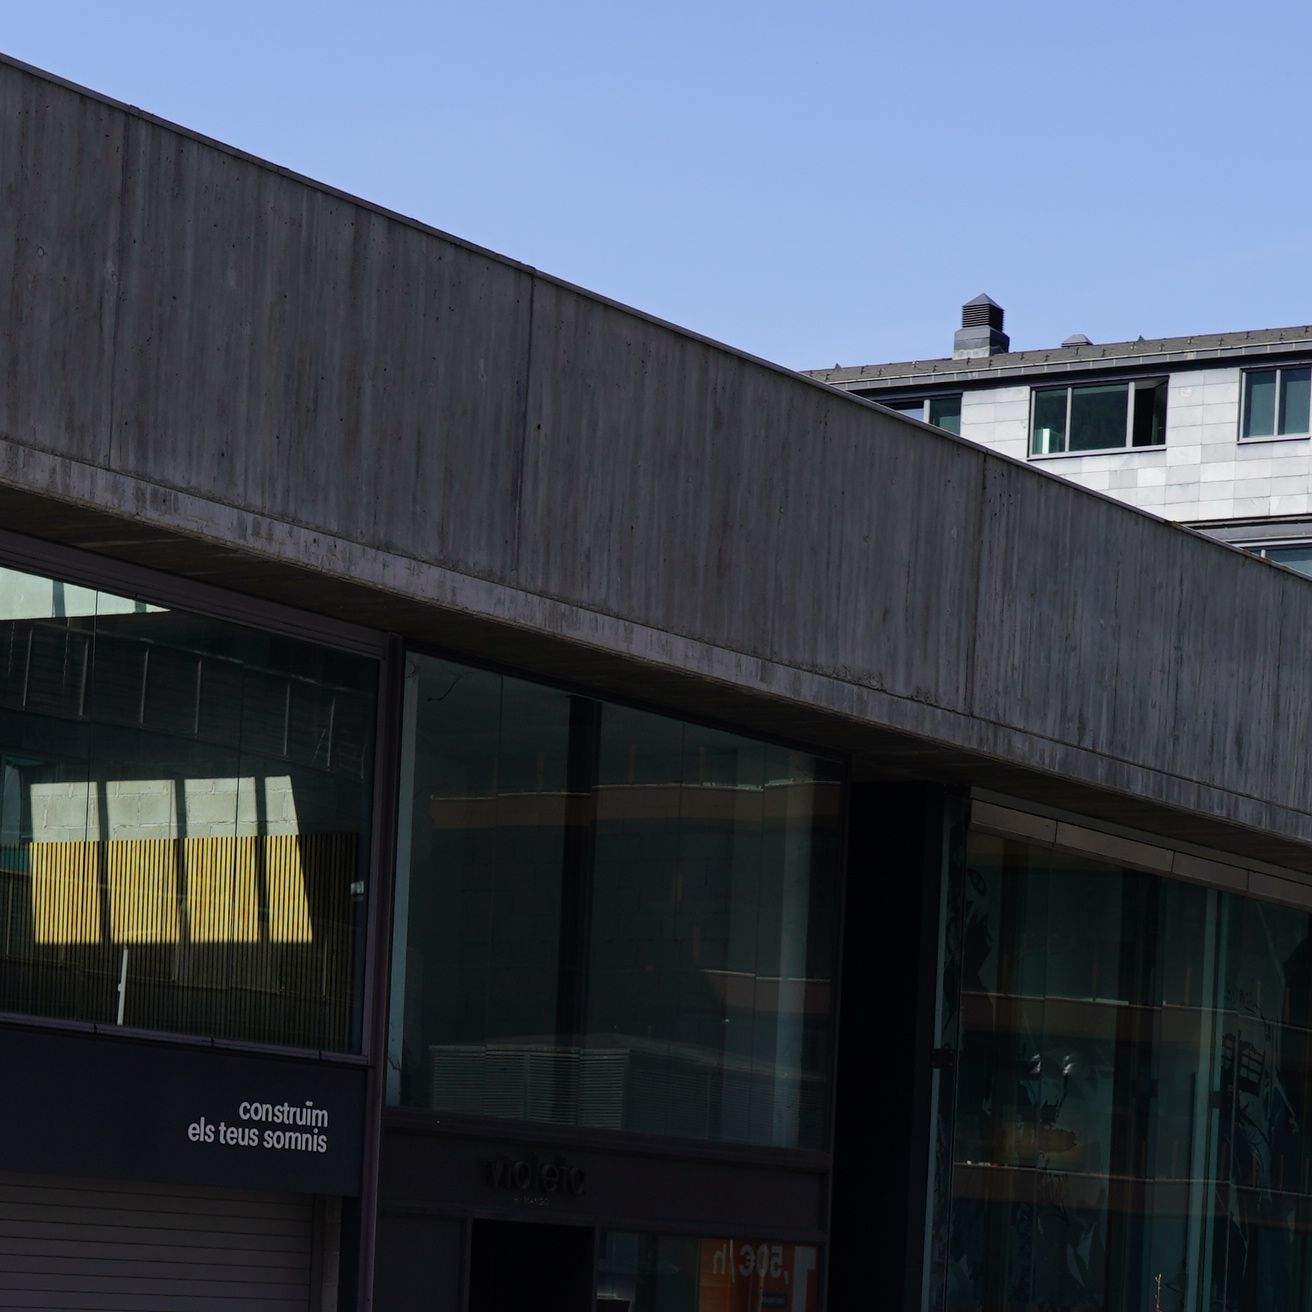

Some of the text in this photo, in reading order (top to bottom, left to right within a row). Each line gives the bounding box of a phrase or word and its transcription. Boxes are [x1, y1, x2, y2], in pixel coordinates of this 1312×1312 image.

[188, 1117, 328, 1153] els teus somnis
